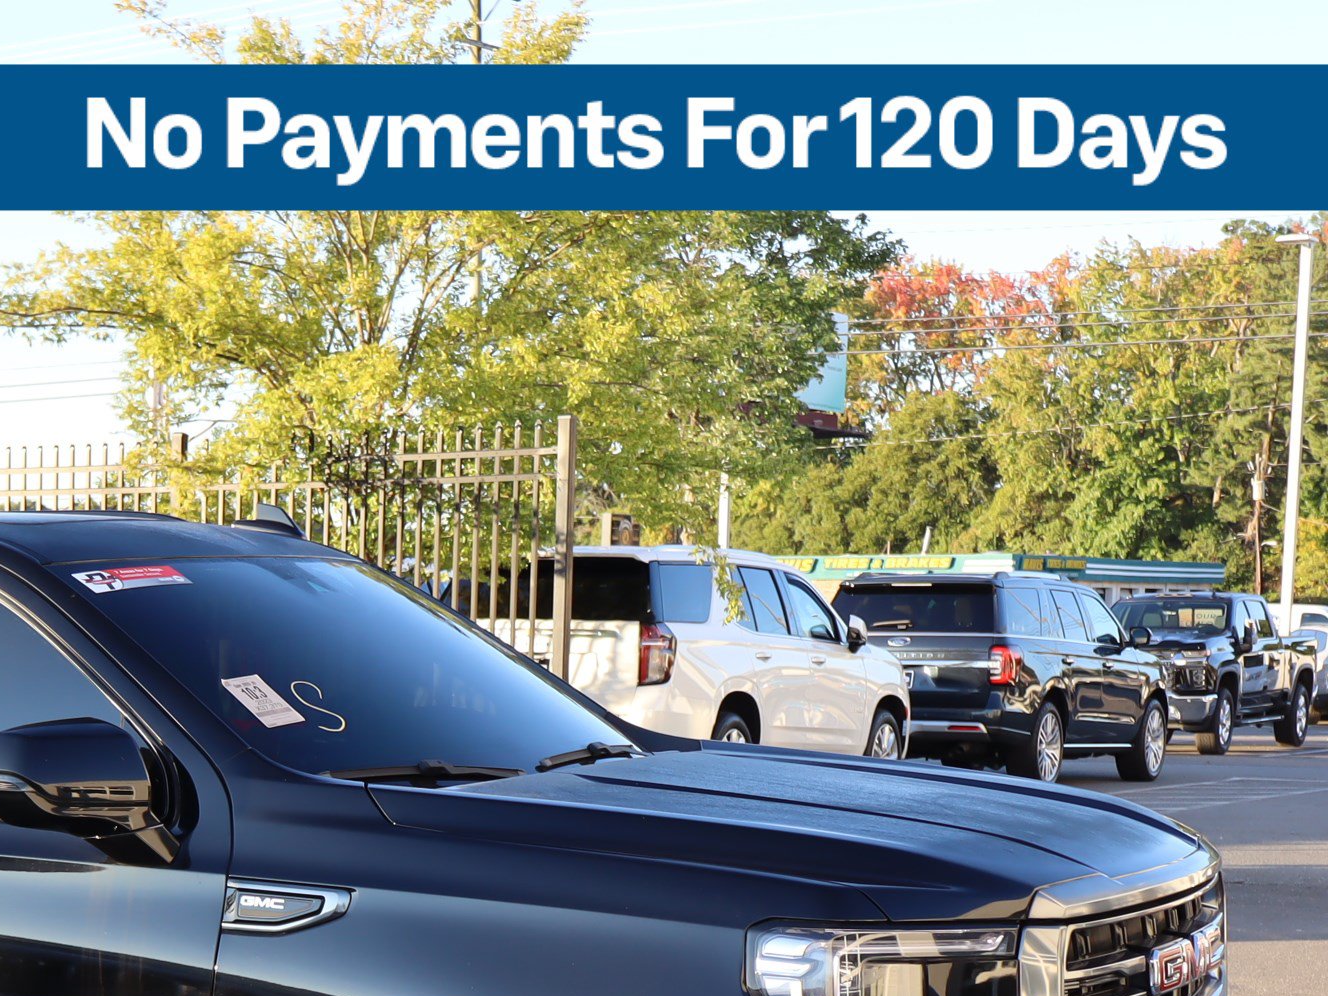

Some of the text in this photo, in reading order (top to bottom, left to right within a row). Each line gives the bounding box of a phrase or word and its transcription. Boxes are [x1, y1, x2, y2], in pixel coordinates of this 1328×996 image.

[824, 557, 870, 570] TIRES
[885, 557, 953, 570] BRAKES
[290, 680, 346, 733] S
[239, 895, 285, 910] GMC
[1150, 922, 1224, 996] GMC
